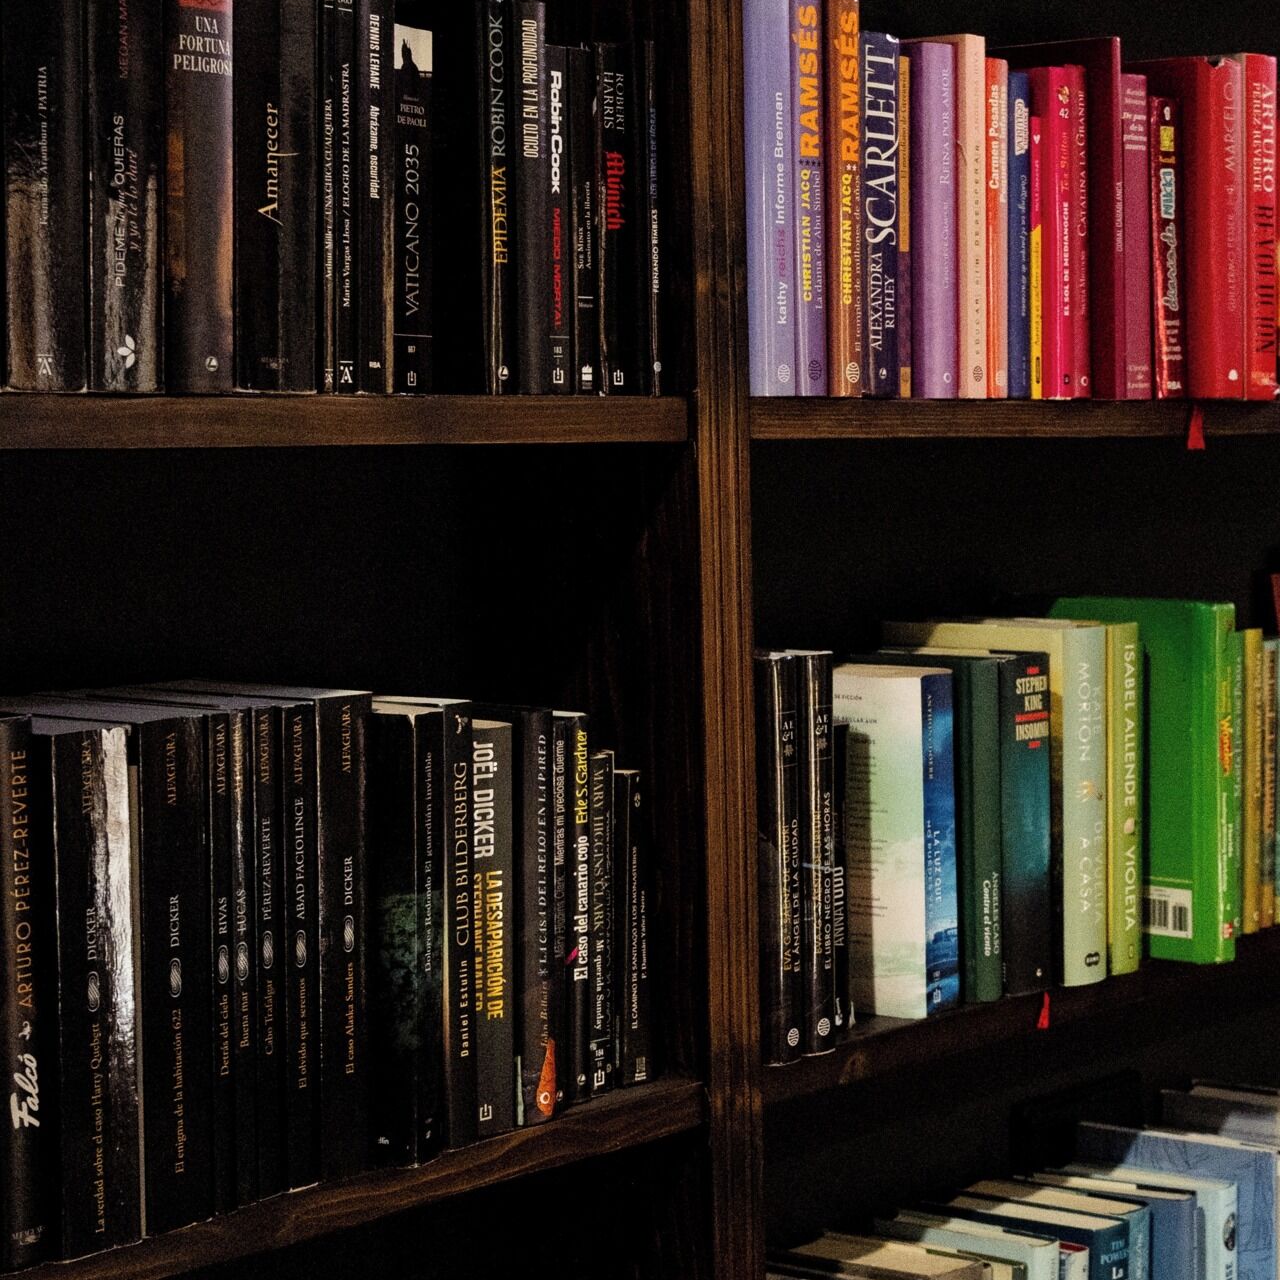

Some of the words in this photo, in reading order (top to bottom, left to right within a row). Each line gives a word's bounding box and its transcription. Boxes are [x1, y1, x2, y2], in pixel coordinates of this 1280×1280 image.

[179, 35, 230, 57] FORTUNA
[195, 16, 218, 34] UNA
[488, 13, 504, 82] COOK
[522, 19, 538, 86] PROFUNDIDAD
[38, 65, 48, 110] PATRIA
[522, 88, 538, 101] LA
[603, 71, 614, 130] HARRIS
[615, 72, 625, 133] ROBERT
[792, 5, 818, 158] RAMSÉS
[834, 11, 859, 161] RAMSÉS
[489, 88, 506, 157] ROBIN
[522, 104, 538, 119] EN
[774, 91, 785, 159] Brennan
[989, 84, 1000, 137] Posadas
[1059, 108, 1070, 119] 42
[1222, 83, 1234, 172] MARCELO
[1261, 83, 1275, 193] ARTURO
[114, 115, 126, 184] QUIERAS
[257, 102, 300, 225] Amanecer
[522, 121, 538, 158] OCULTO
[864, 44, 899, 245] SCARLETT
[989, 142, 1000, 190] Carmen
[405, 144, 420, 199] 2035
[775, 163, 786, 224] Informe
[800, 168, 812, 214] JACQ
[841, 173, 853, 218] JACQ
[491, 165, 508, 264] EPIDEMIA
[551, 206, 563, 259] MIEDO
[1062, 201, 1070, 267] MEDIANOCHE
[405, 204, 420, 317] VATICANO
[801, 218, 812, 302] CHRISTIAN
[842, 221, 853, 305] CHRISTIAN
[776, 280, 787, 324] kathy
[870, 251, 883, 351] ALEXANDRA
[884, 275, 895, 329] RIPLEY
[1024, 694, 1042, 712] KING
[1123, 644, 1136, 712] ISABEL
[1078, 661, 1091, 762] MORTON
[473, 741, 498, 787] JOËL
[576, 730, 588, 778] Gardner
[1123, 719, 1136, 807] ALLENDE
[13, 749, 31, 912] PÉREZ-REVERTE
[294, 797, 305, 878] FACIOLINCE
[454, 762, 468, 888] BILDERBERG
[473, 791, 495, 858] DICKER
[576, 800, 587, 825] Erle
[823, 792, 832, 831] HORAS
[261, 817, 272, 921] PÉREZ-REVERTE
[573, 836, 589, 859] cojo
[1079, 837, 1090, 849] A
[295, 881, 306, 920] ABAD
[343, 856, 353, 905] DICKER
[485, 870, 503, 890] LA
[573, 862, 588, 912] canario
[1079, 857, 1091, 913] CASA
[1122, 845, 1137, 932] VIOLETA
[87, 906, 99, 960] DICKER
[169, 894, 180, 948] DICKER
[218, 897, 228, 935] RIVAS
[455, 891, 470, 948] CLUB
[573, 914, 587, 936] del
[16, 921, 33, 1008] ARTURO
[486, 892, 505, 997] DESAPARICIÓN
[574, 937, 588, 964] caso
[460, 958, 469, 1007] Estulin
[573, 967, 588, 981] El
[460, 1012, 470, 1058] Daniel
[487, 999, 503, 1020] DE
[9, 1053, 41, 1130] Falcó
